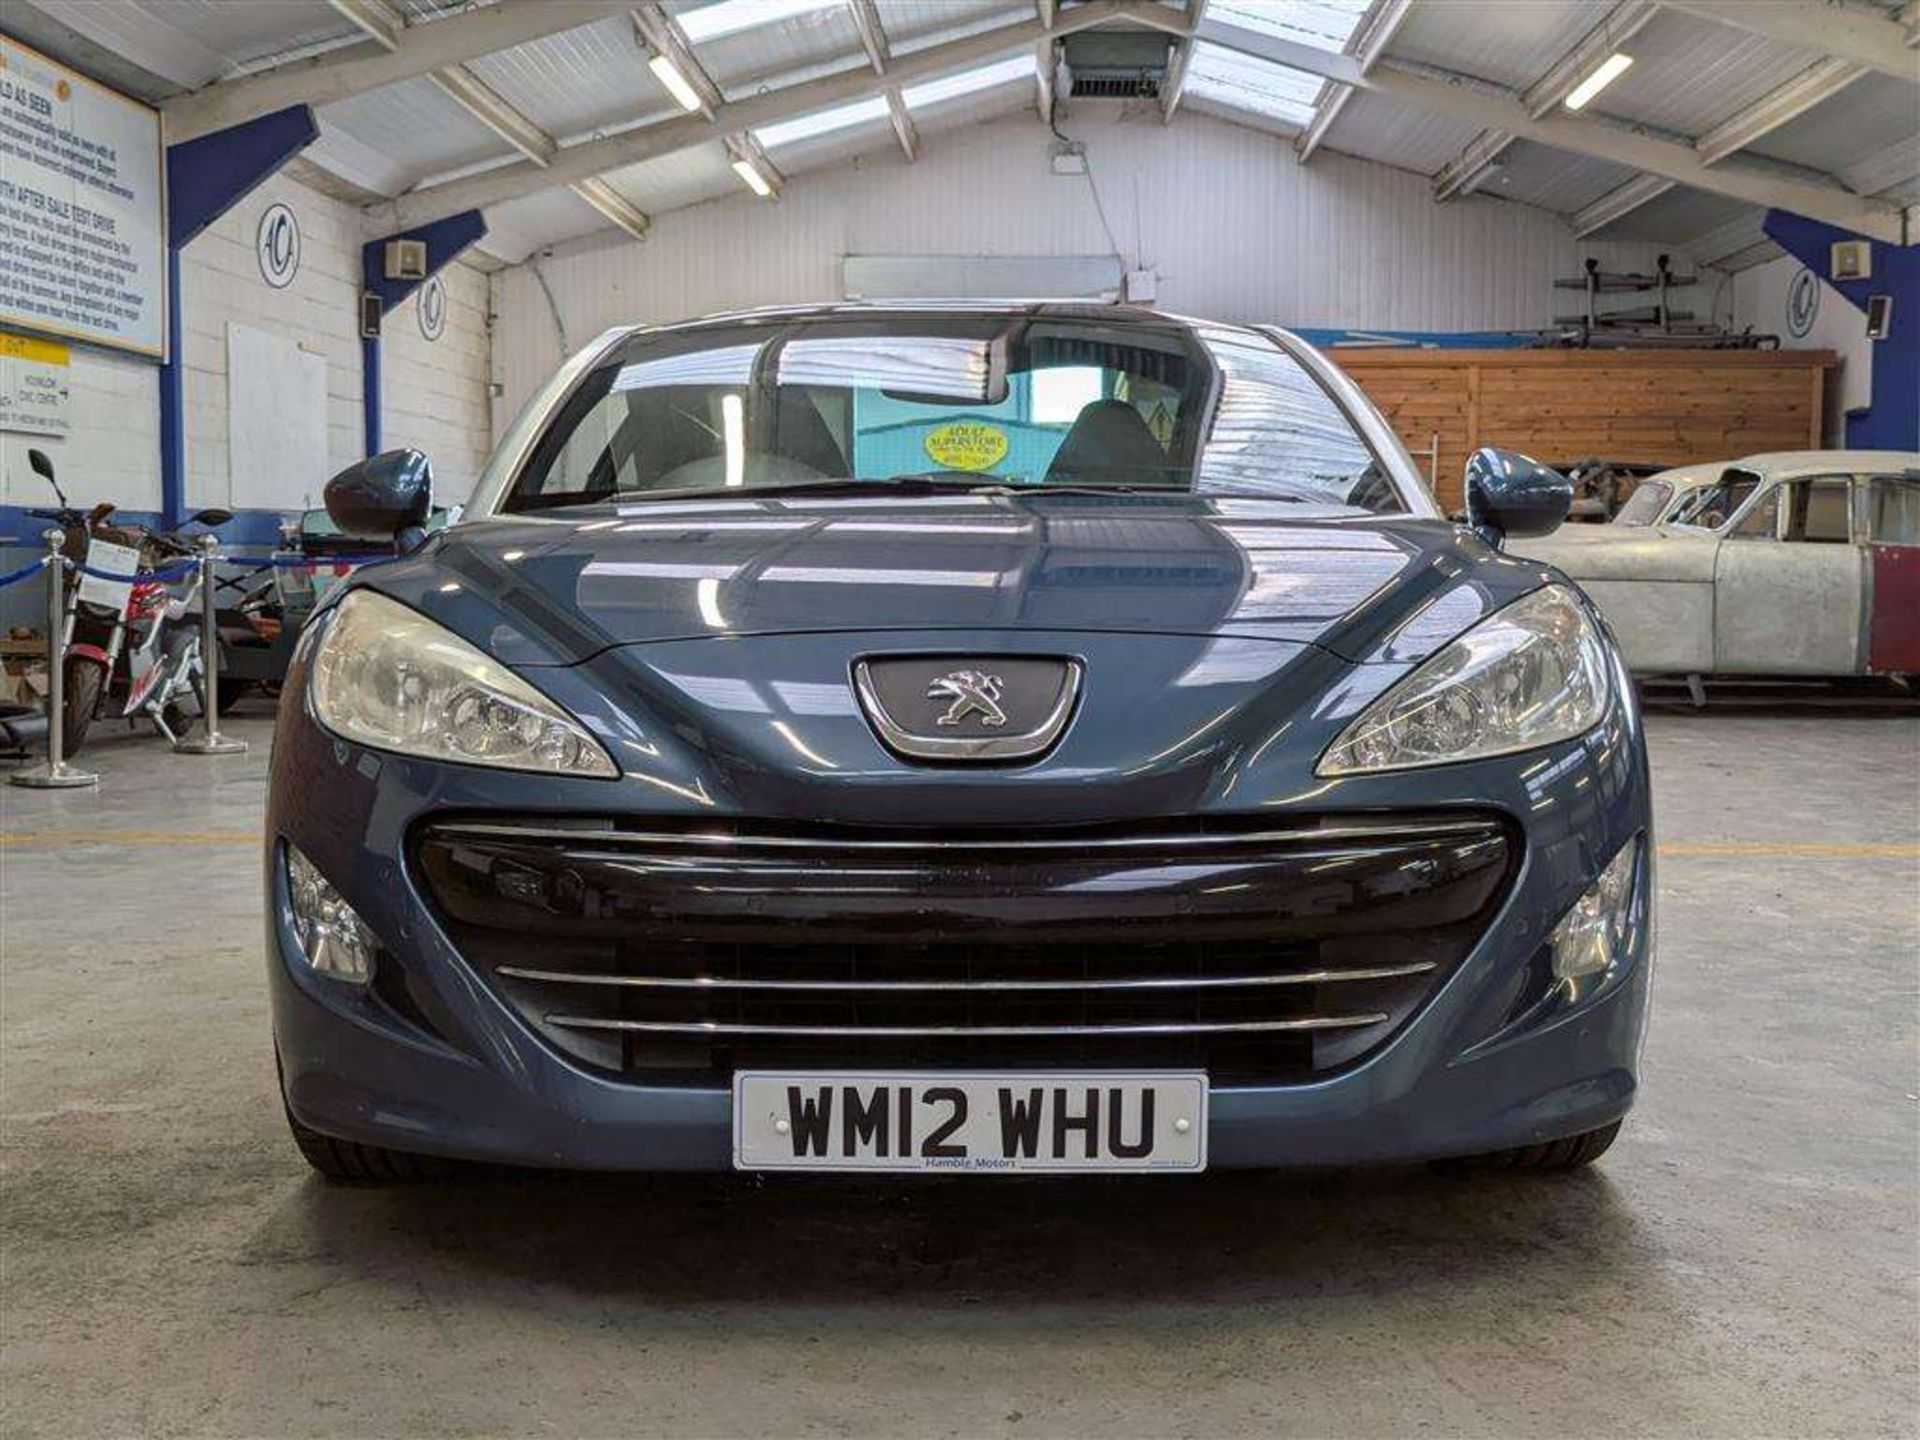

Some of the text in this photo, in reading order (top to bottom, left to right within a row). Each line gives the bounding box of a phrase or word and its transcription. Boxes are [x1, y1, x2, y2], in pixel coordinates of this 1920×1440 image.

[14, 85, 26, 106] AS
[28, 92, 52, 117] SEEN
[17, 186, 45, 210] AFTER
[47, 197, 70, 218] SALE
[71, 205, 91, 226] TEST
[92, 213, 115, 234] DRIVE
[787, 1087, 1155, 1158] WM12 WHU
[924, 1157, 1017, 1170] Hamble Motors
